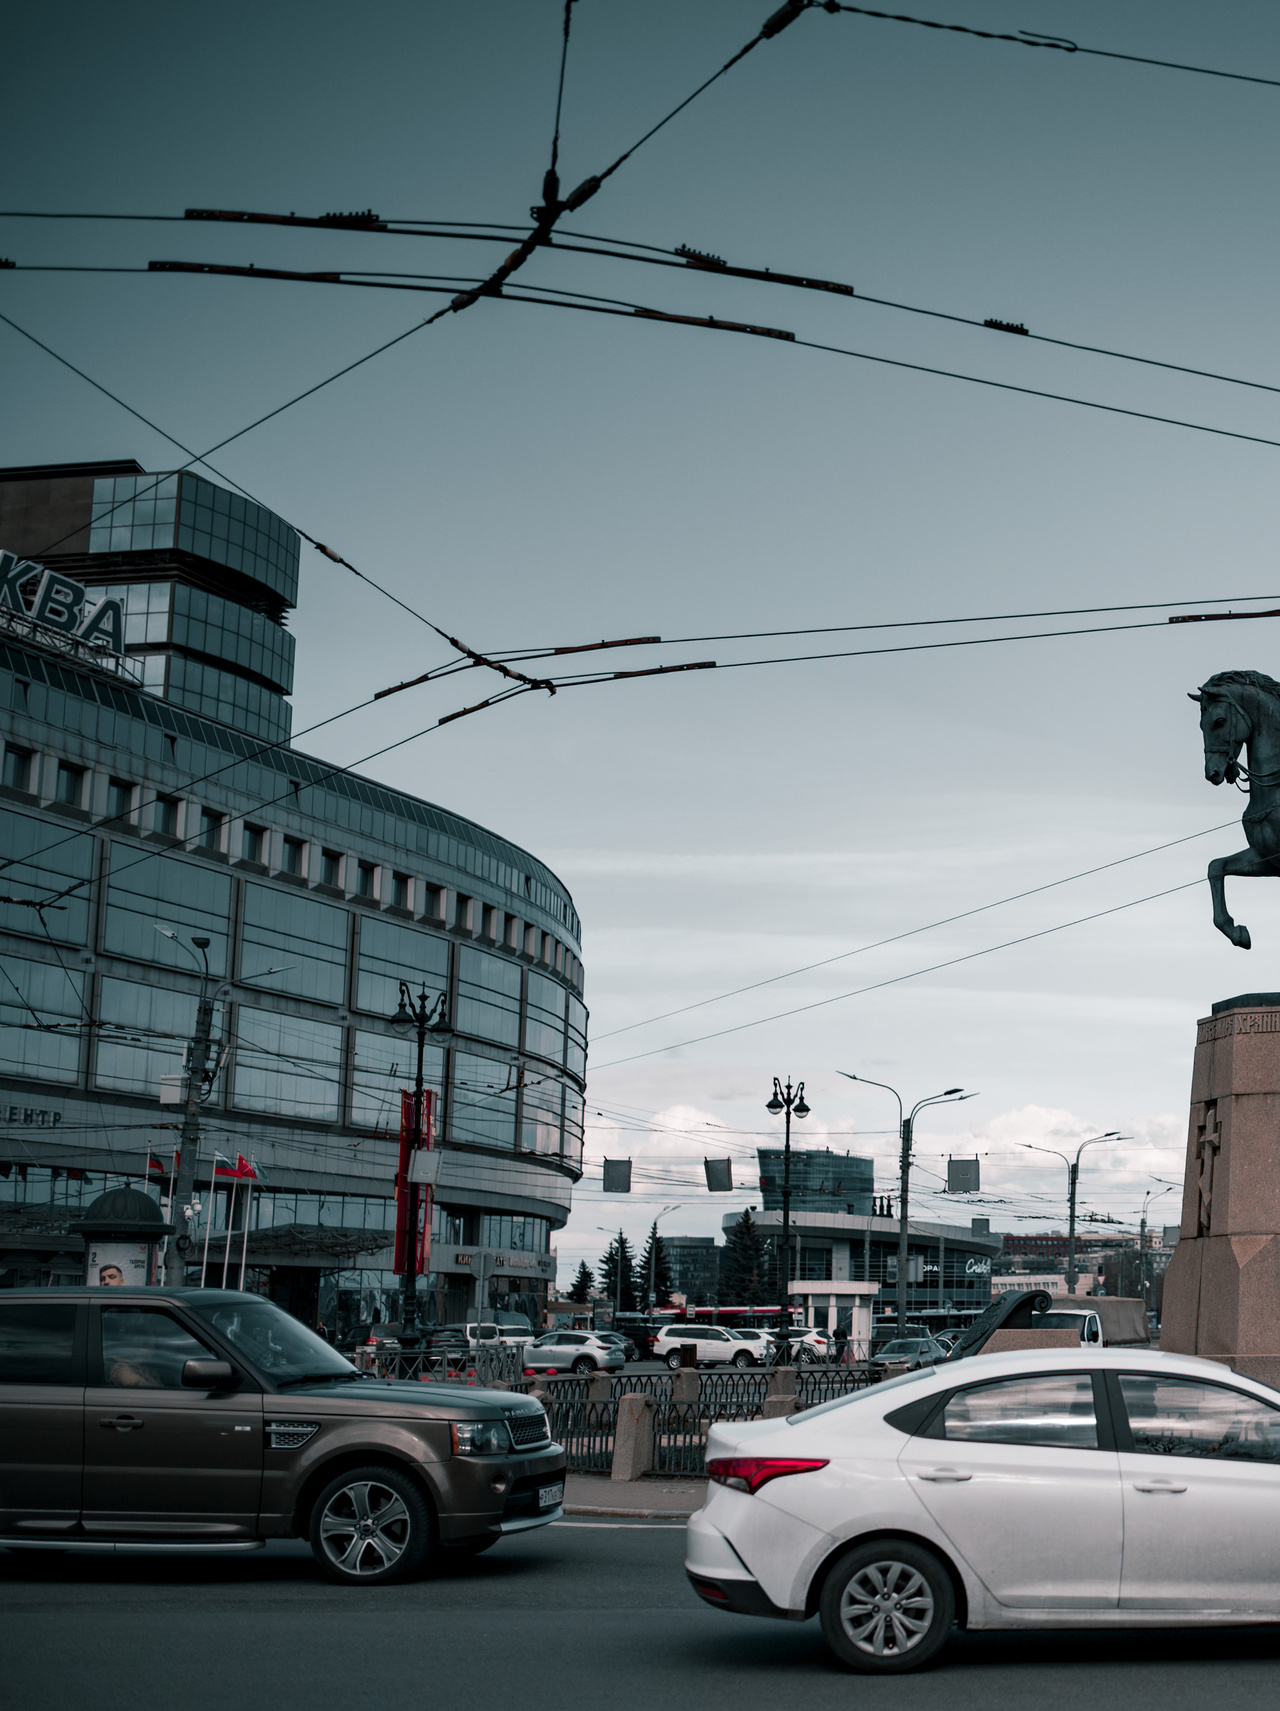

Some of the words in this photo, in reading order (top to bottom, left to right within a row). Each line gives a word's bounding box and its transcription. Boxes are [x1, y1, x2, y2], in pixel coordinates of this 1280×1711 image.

[0, 550, 125, 658] КВА
[0, 1104, 61, 1127] ЕНТР
[92, 1252, 97, 1262] 2
